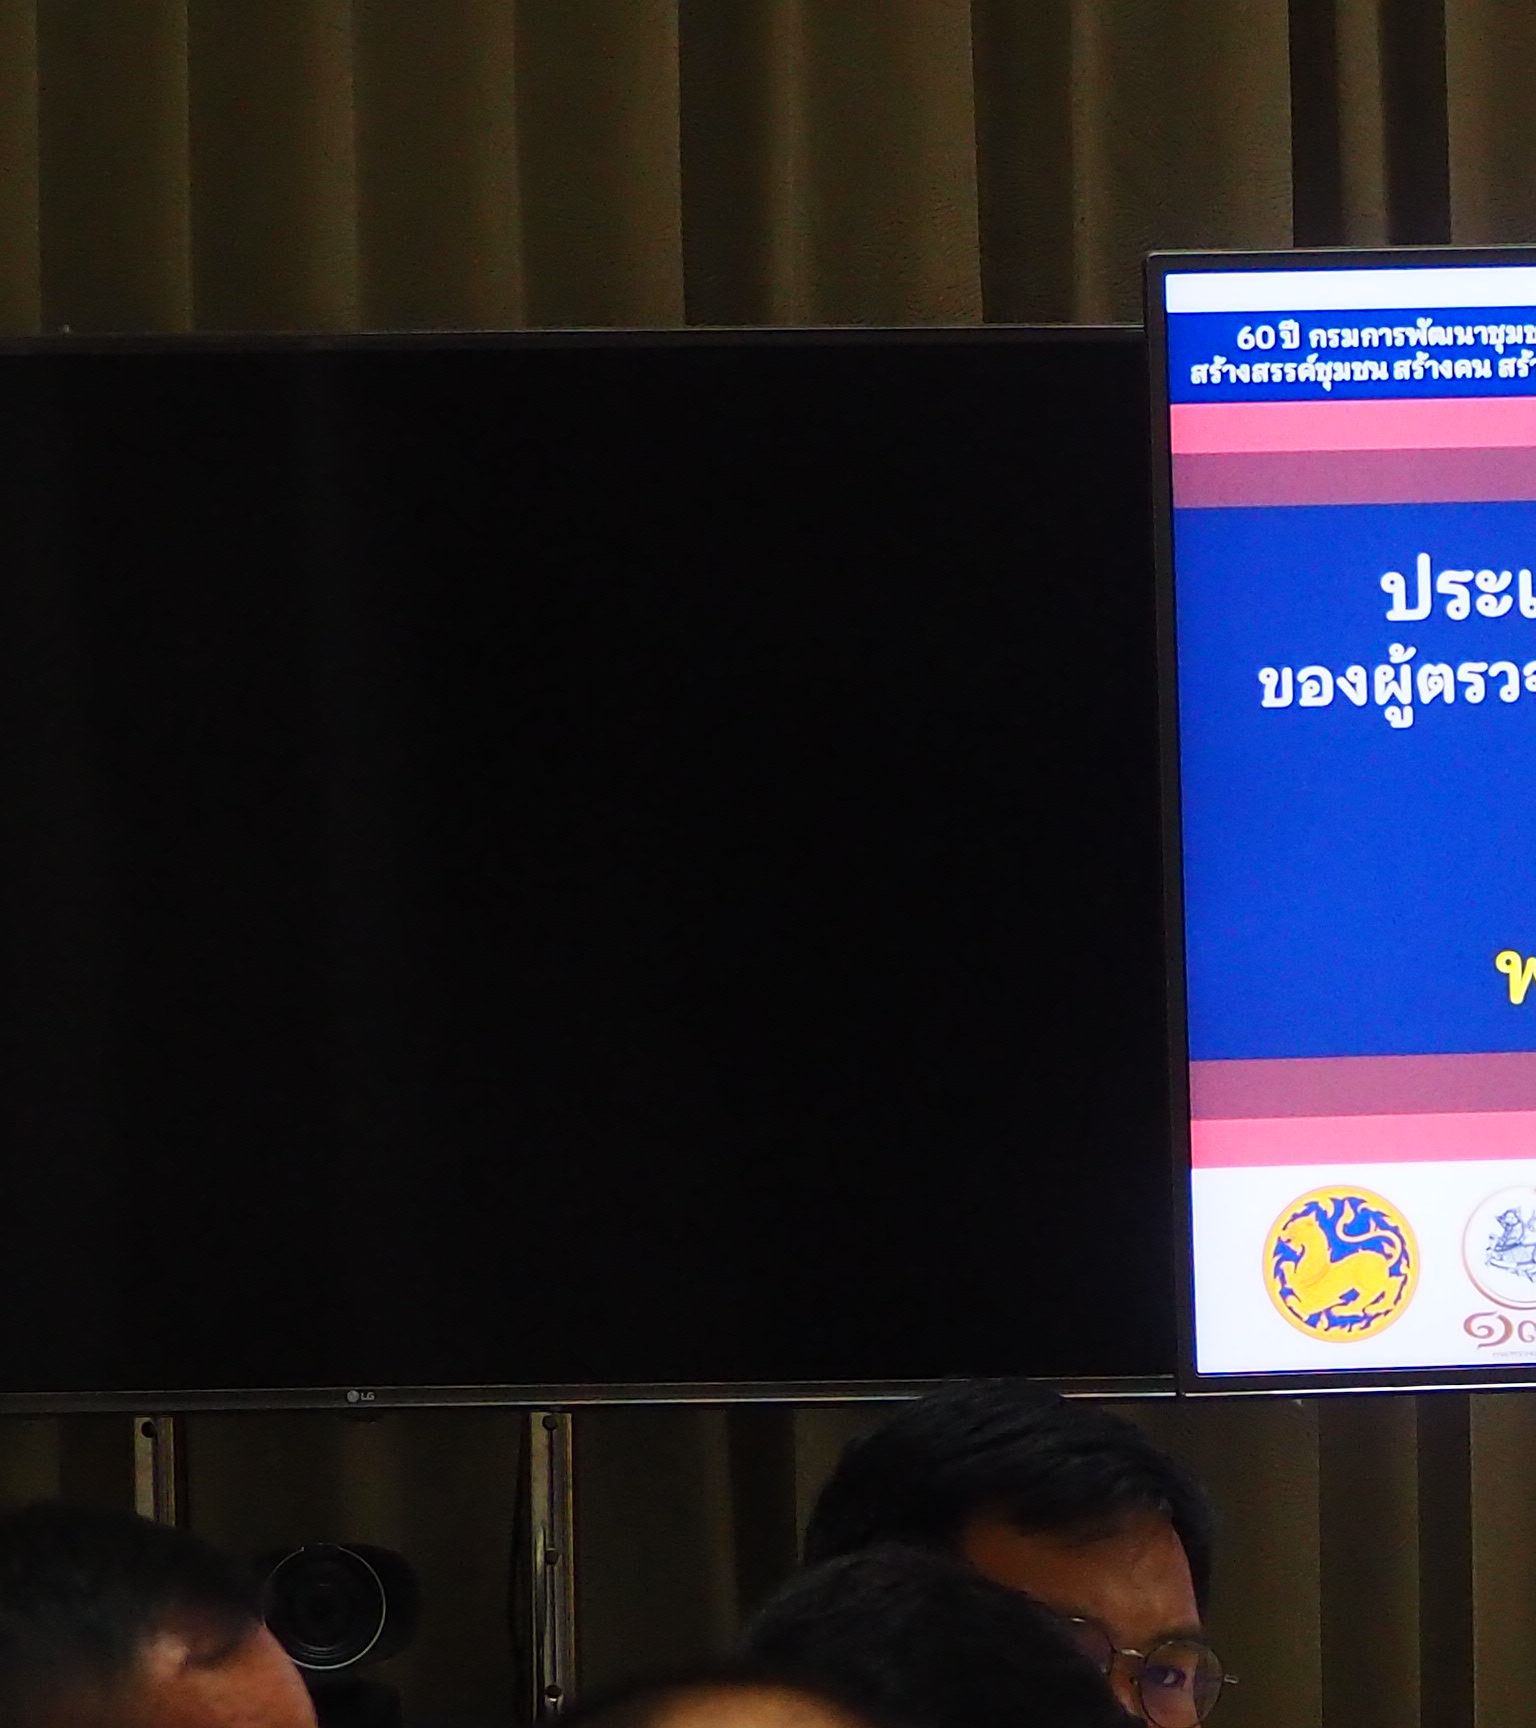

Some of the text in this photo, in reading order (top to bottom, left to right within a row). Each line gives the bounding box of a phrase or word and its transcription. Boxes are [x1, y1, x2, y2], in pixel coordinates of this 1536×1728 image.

[1237, 324, 1275, 350] 60
[1190, 352, 1389, 392] สร้างสรรค์ชุมชน
[1394, 350, 1492, 381] สร้างคน
